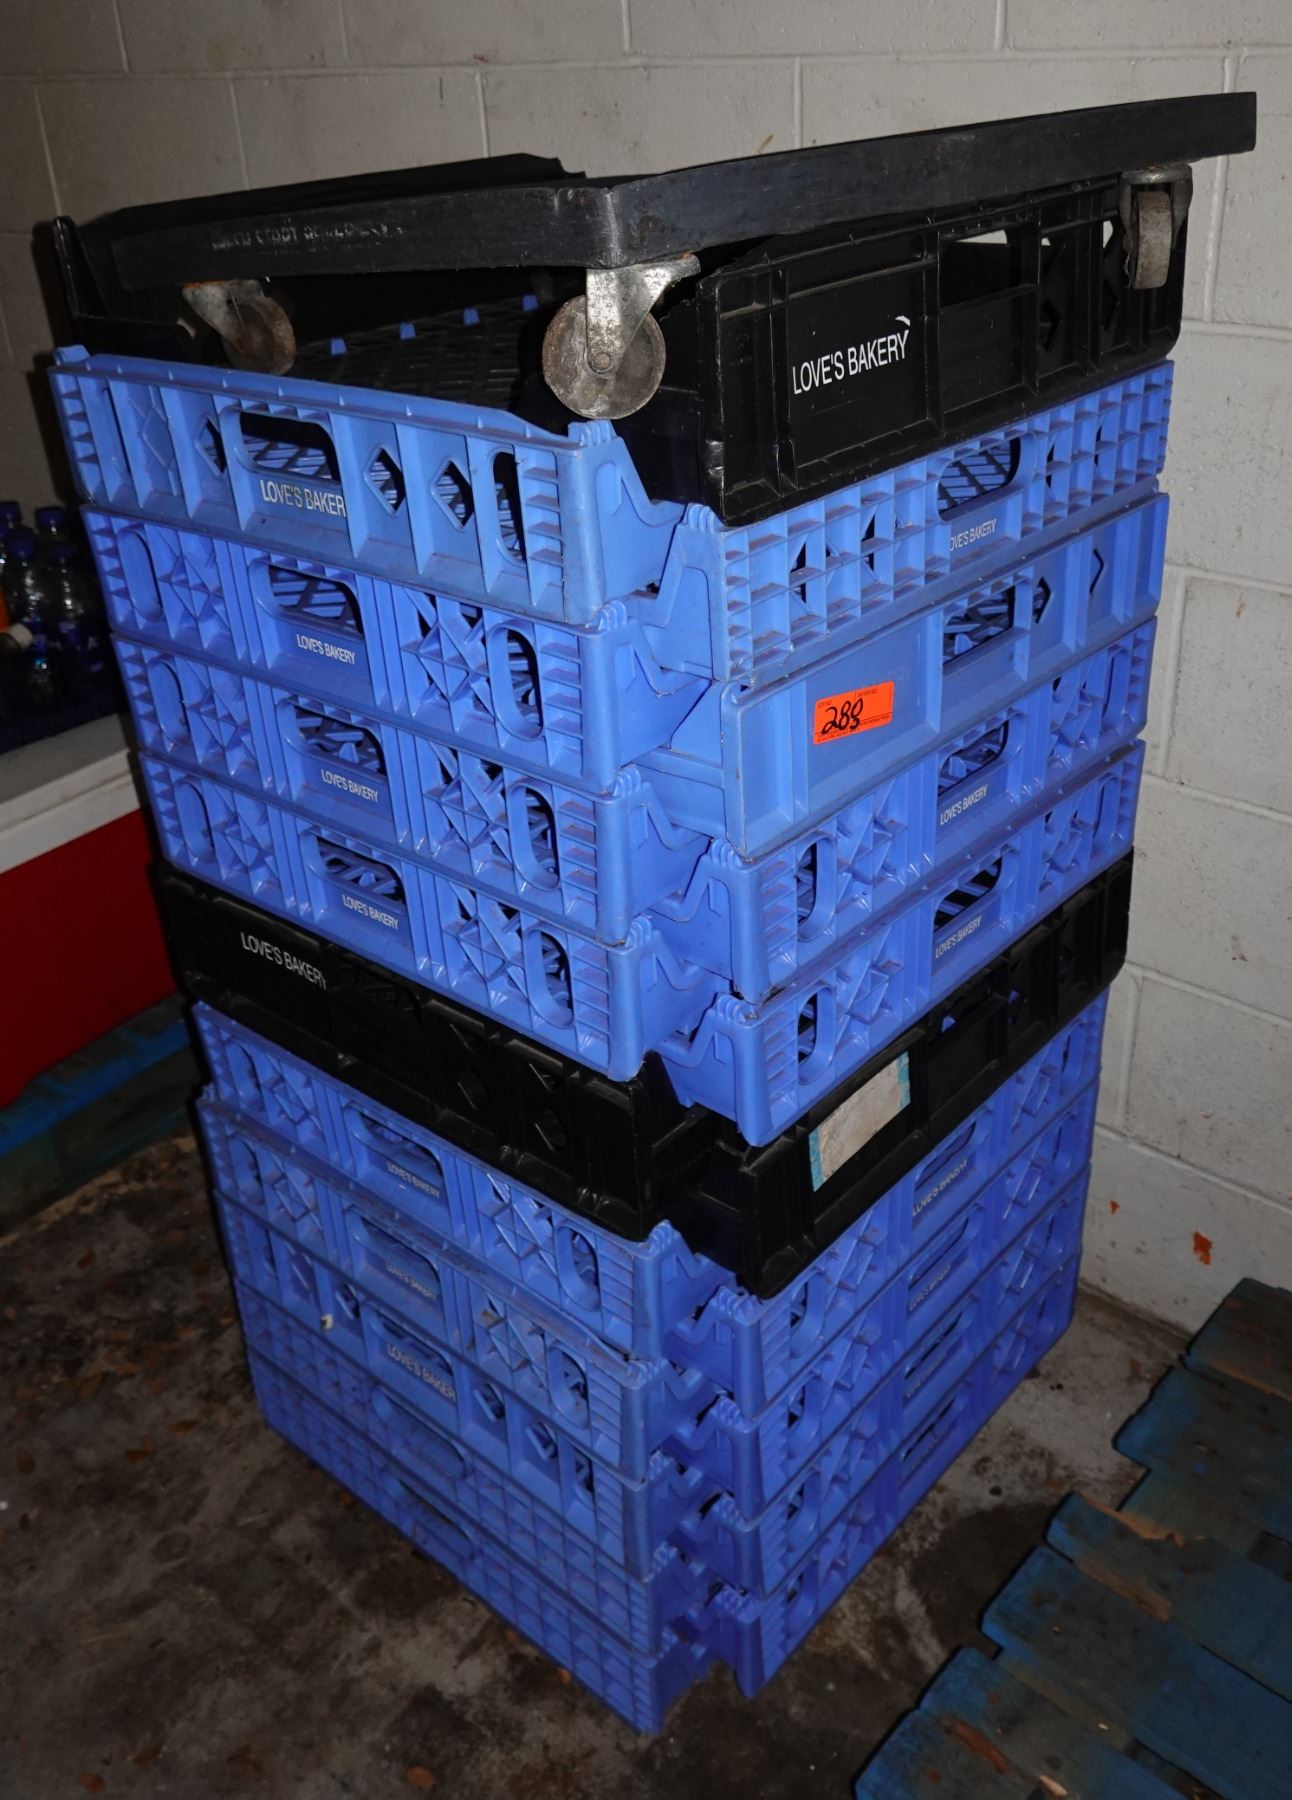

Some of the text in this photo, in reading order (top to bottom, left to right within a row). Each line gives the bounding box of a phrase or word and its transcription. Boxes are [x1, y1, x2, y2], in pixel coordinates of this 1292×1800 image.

[792, 329, 909, 395] LOVE'S BAKERY
[260, 479, 346, 518] LOVE'S BAKER
[950, 518, 997, 552] OVE'S BAKERY
[296, 633, 355, 665] LOVE'S BAKERY
[321, 769, 378, 803] LOVE'S BAKERY
[940, 783, 988, 826] LOVE'S BAKERY
[342, 894, 399, 931] LOVE'S BAKERY
[240, 932, 283, 966] LOVE'S
[935, 915, 982, 959] LOVE'S BAKERY
[421, 1367, 457, 1403] BAKER
